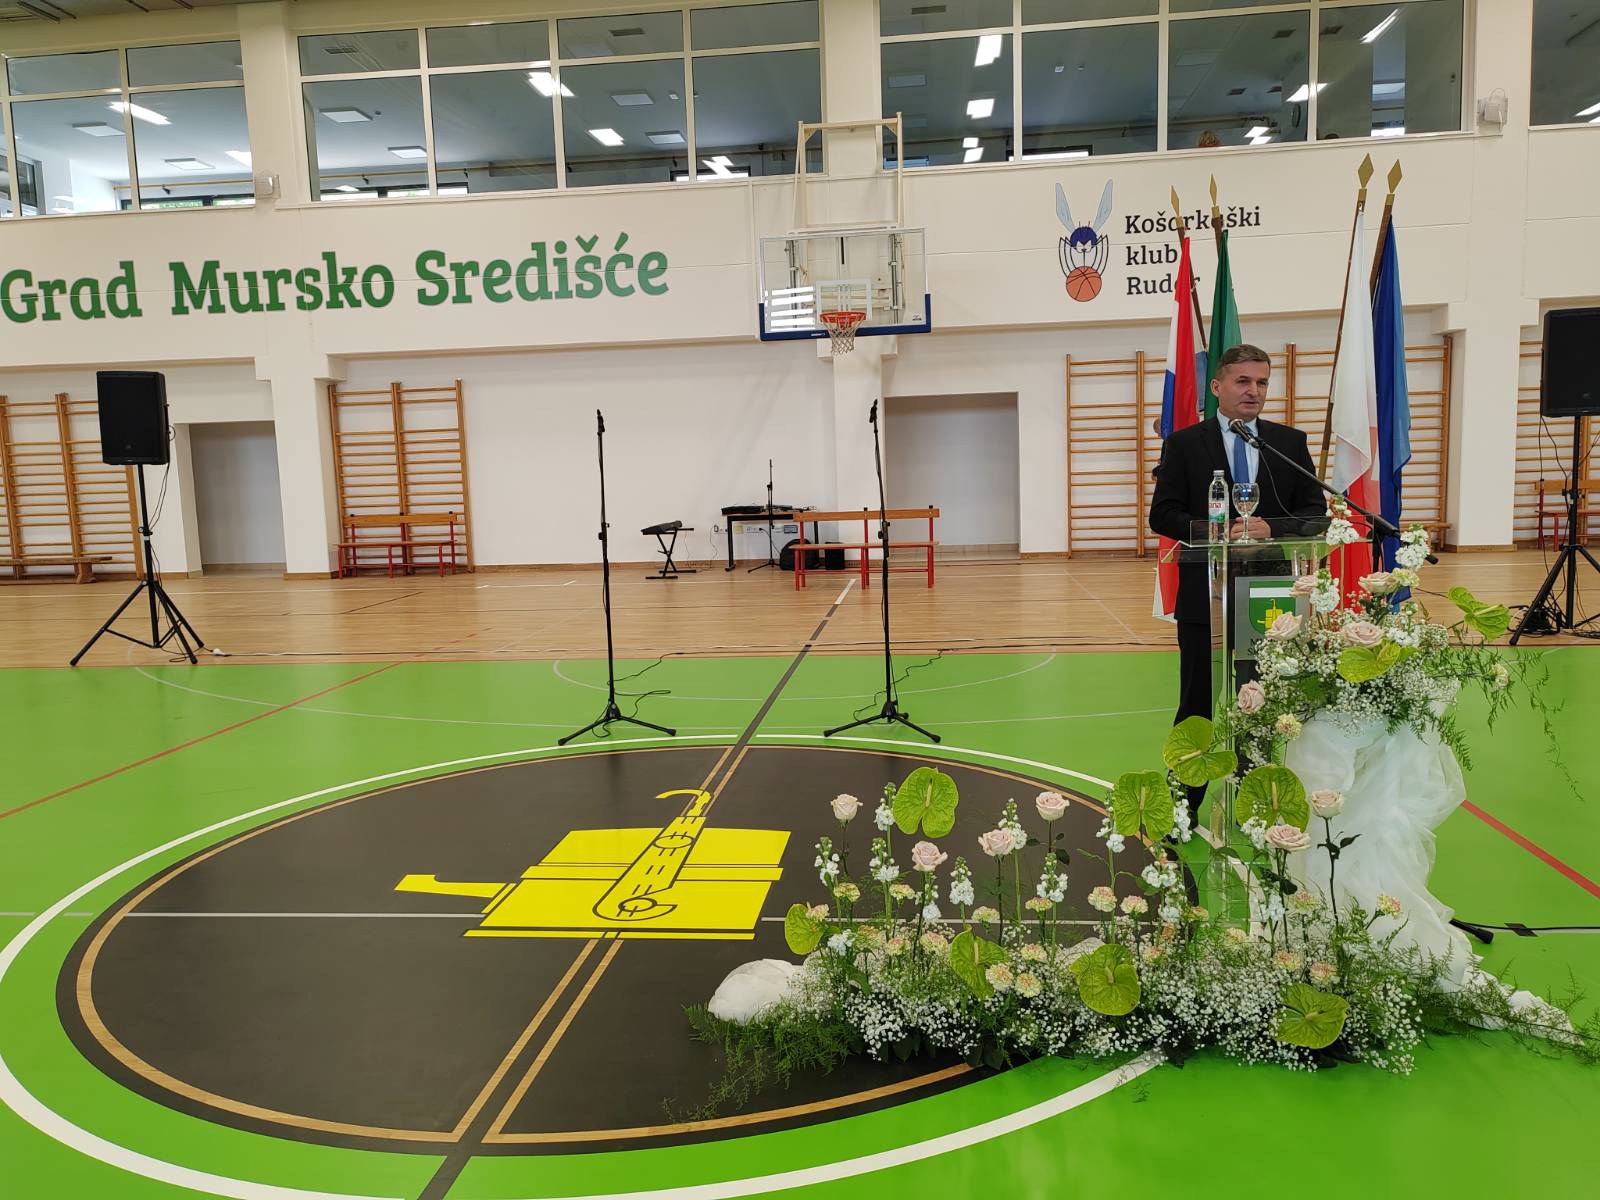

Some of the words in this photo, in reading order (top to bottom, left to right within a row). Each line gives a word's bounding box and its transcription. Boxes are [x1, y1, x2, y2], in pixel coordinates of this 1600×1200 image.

[1126, 243, 1178, 265] klub
[0, 259, 143, 324] Grad
[169, 249, 395, 316] Mursko
[416, 232, 668, 306] Središće
[1126, 273, 1200, 295] Rudr
